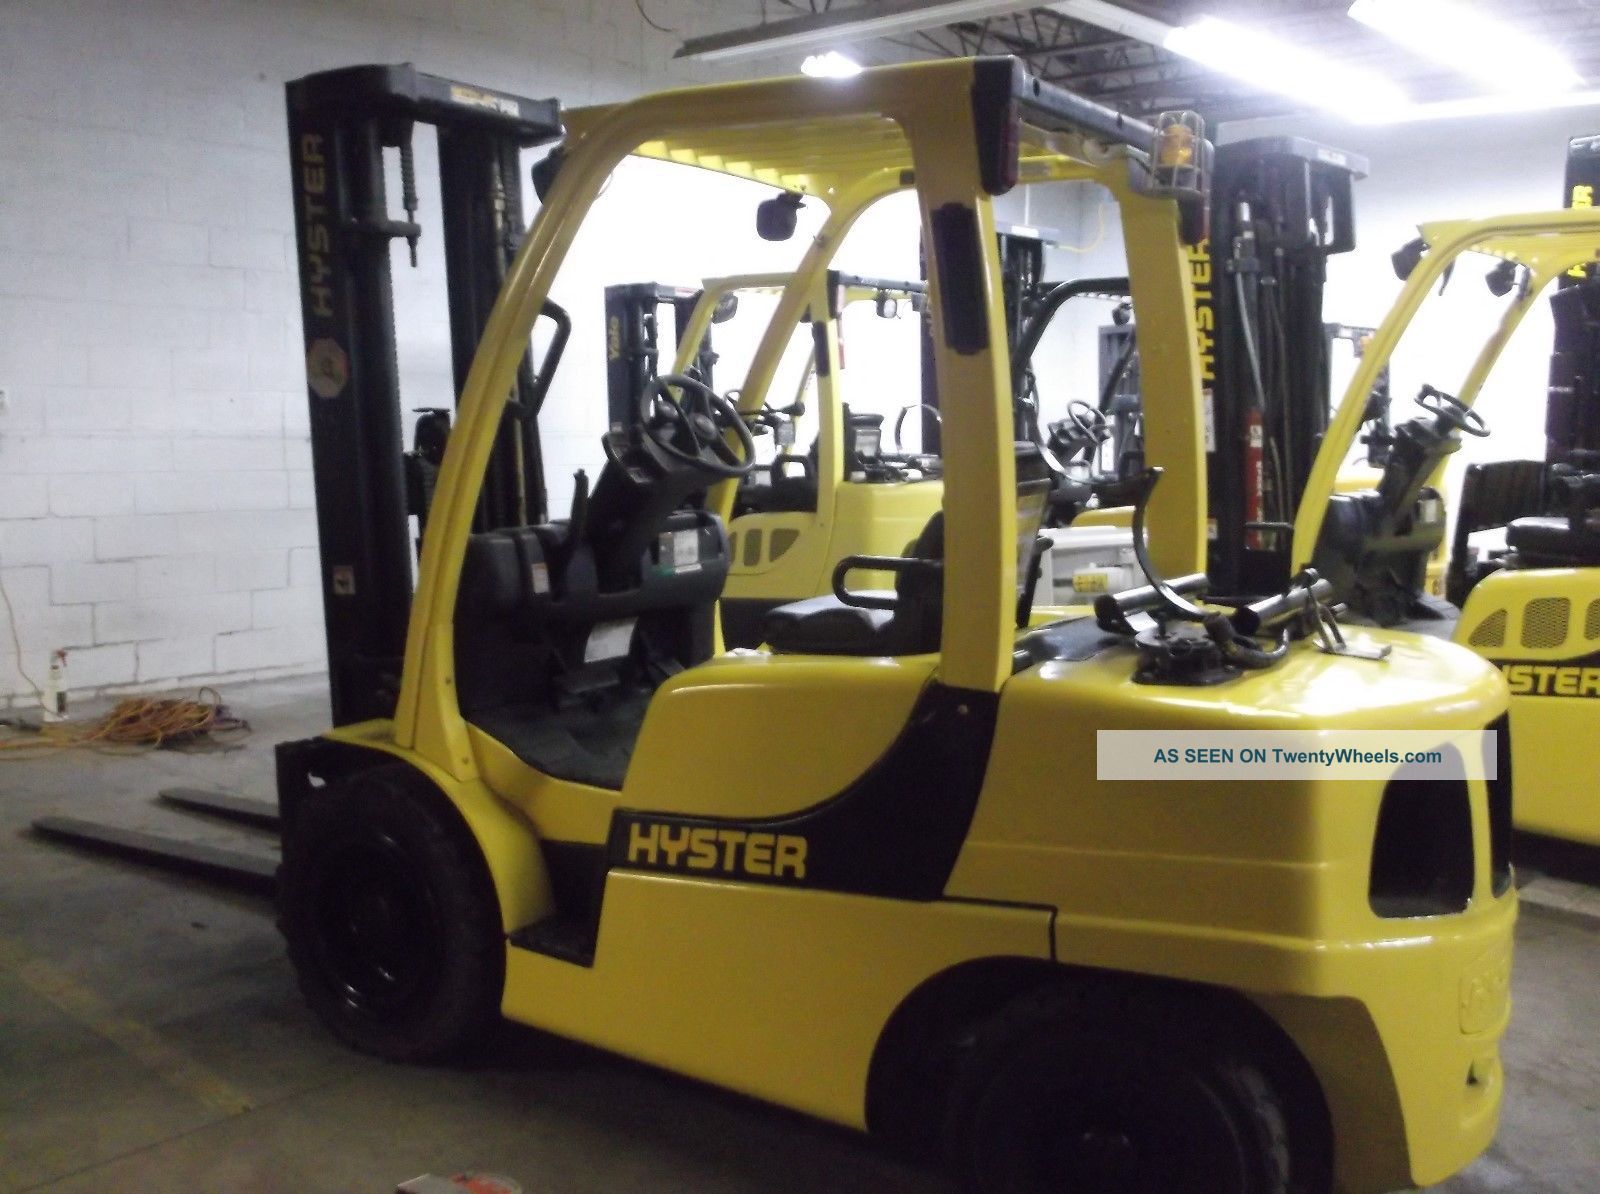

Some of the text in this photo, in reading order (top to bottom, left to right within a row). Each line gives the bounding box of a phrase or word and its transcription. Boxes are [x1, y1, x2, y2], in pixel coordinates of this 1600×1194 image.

[302, 133, 333, 318] HYSTER
[1503, 664, 1600, 696] STER
[627, 822, 808, 879] HYSTER
